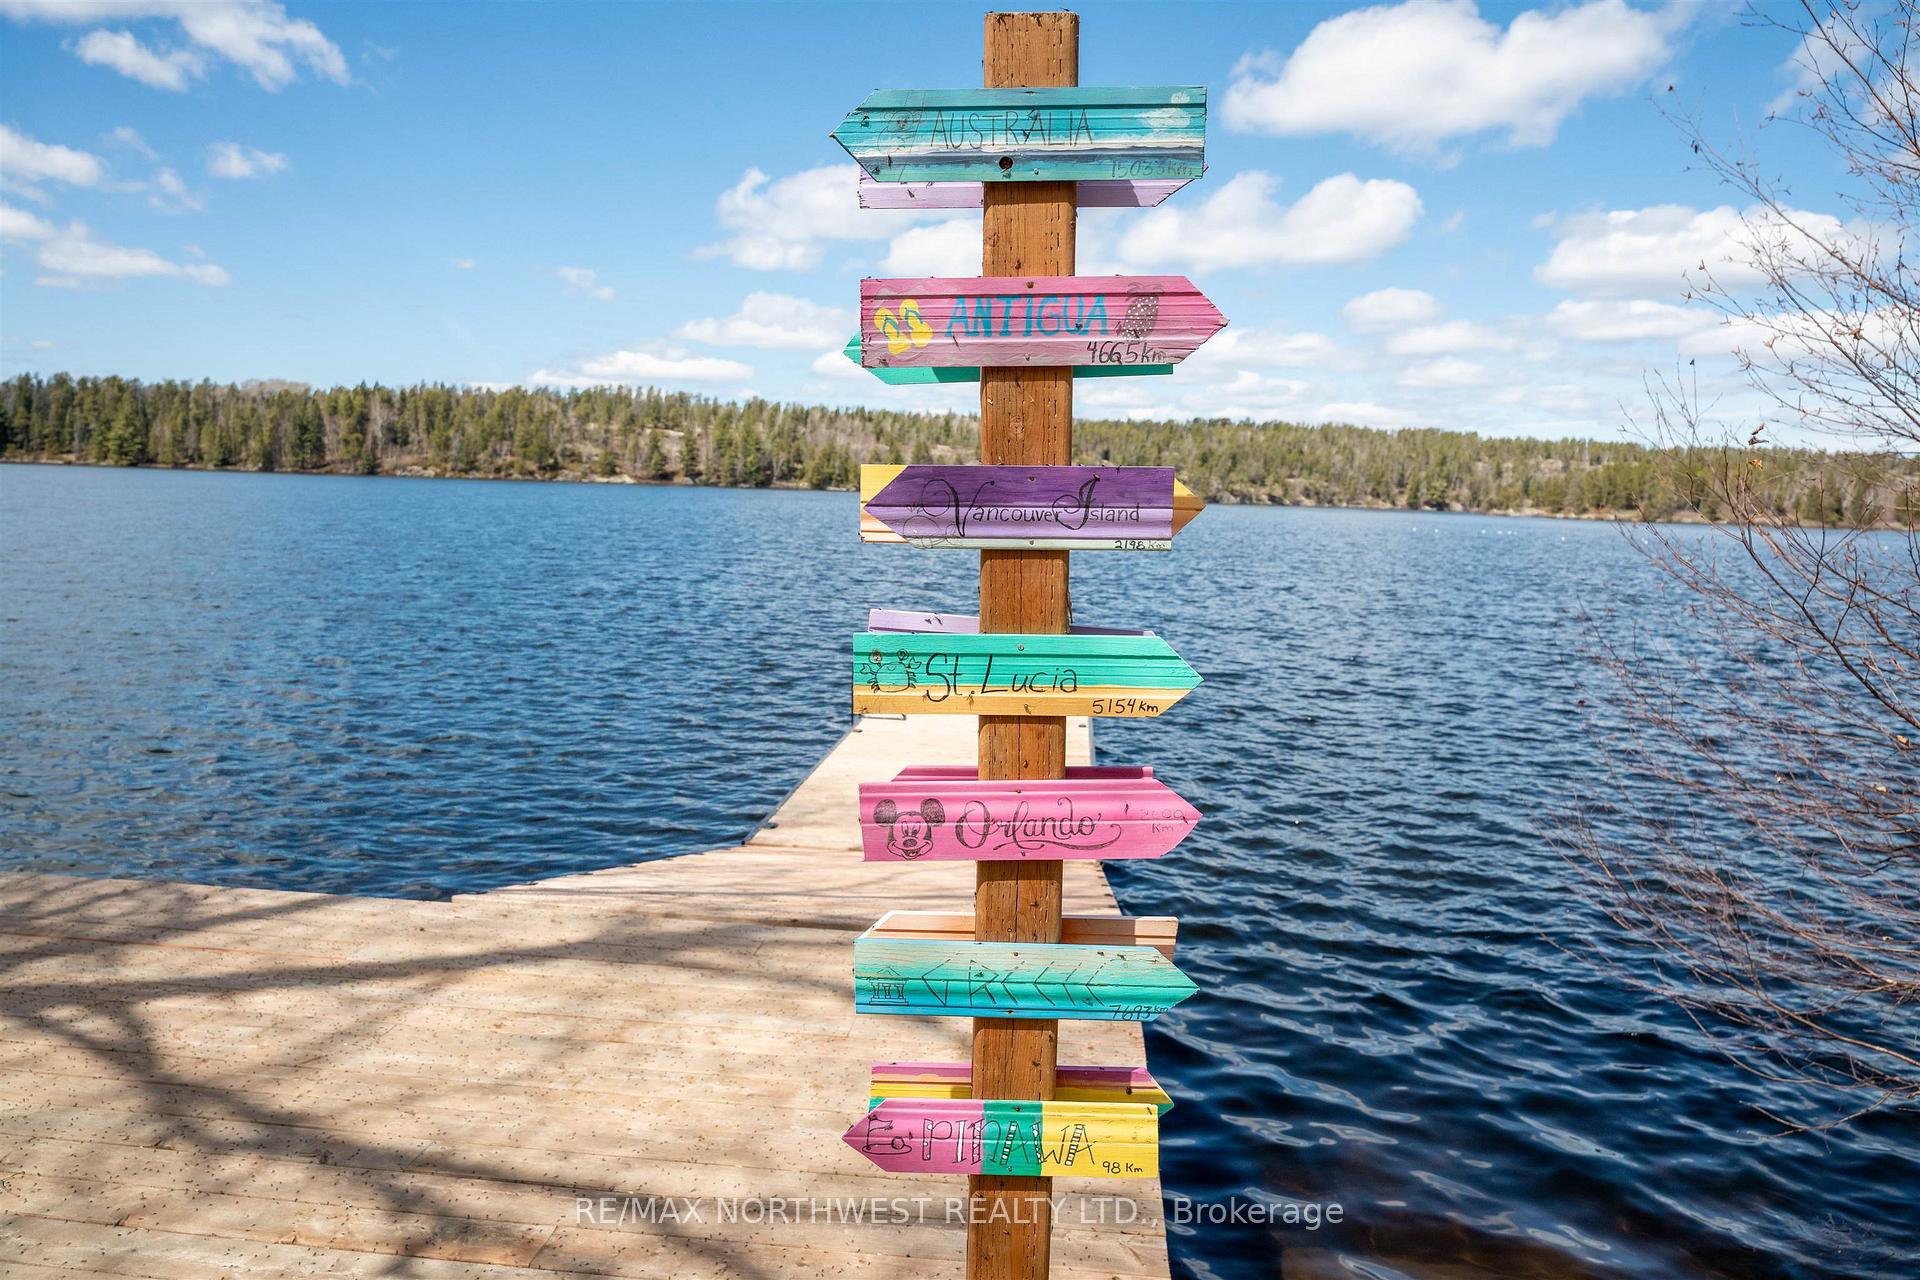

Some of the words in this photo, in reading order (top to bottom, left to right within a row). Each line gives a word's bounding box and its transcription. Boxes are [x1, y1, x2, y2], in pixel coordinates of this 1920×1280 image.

[930, 108, 1094, 150] AUSTRALIA
[944, 294, 1109, 337] ANTIGUA
[921, 478, 1063, 537] Vancouver
[1051, 474, 1140, 530] Island
[925, 652, 975, 703] St.
[980, 653, 1078, 694] Lucia
[955, 796, 1098, 850] Orlando
[1102, 1160, 1121, 1174] 98
